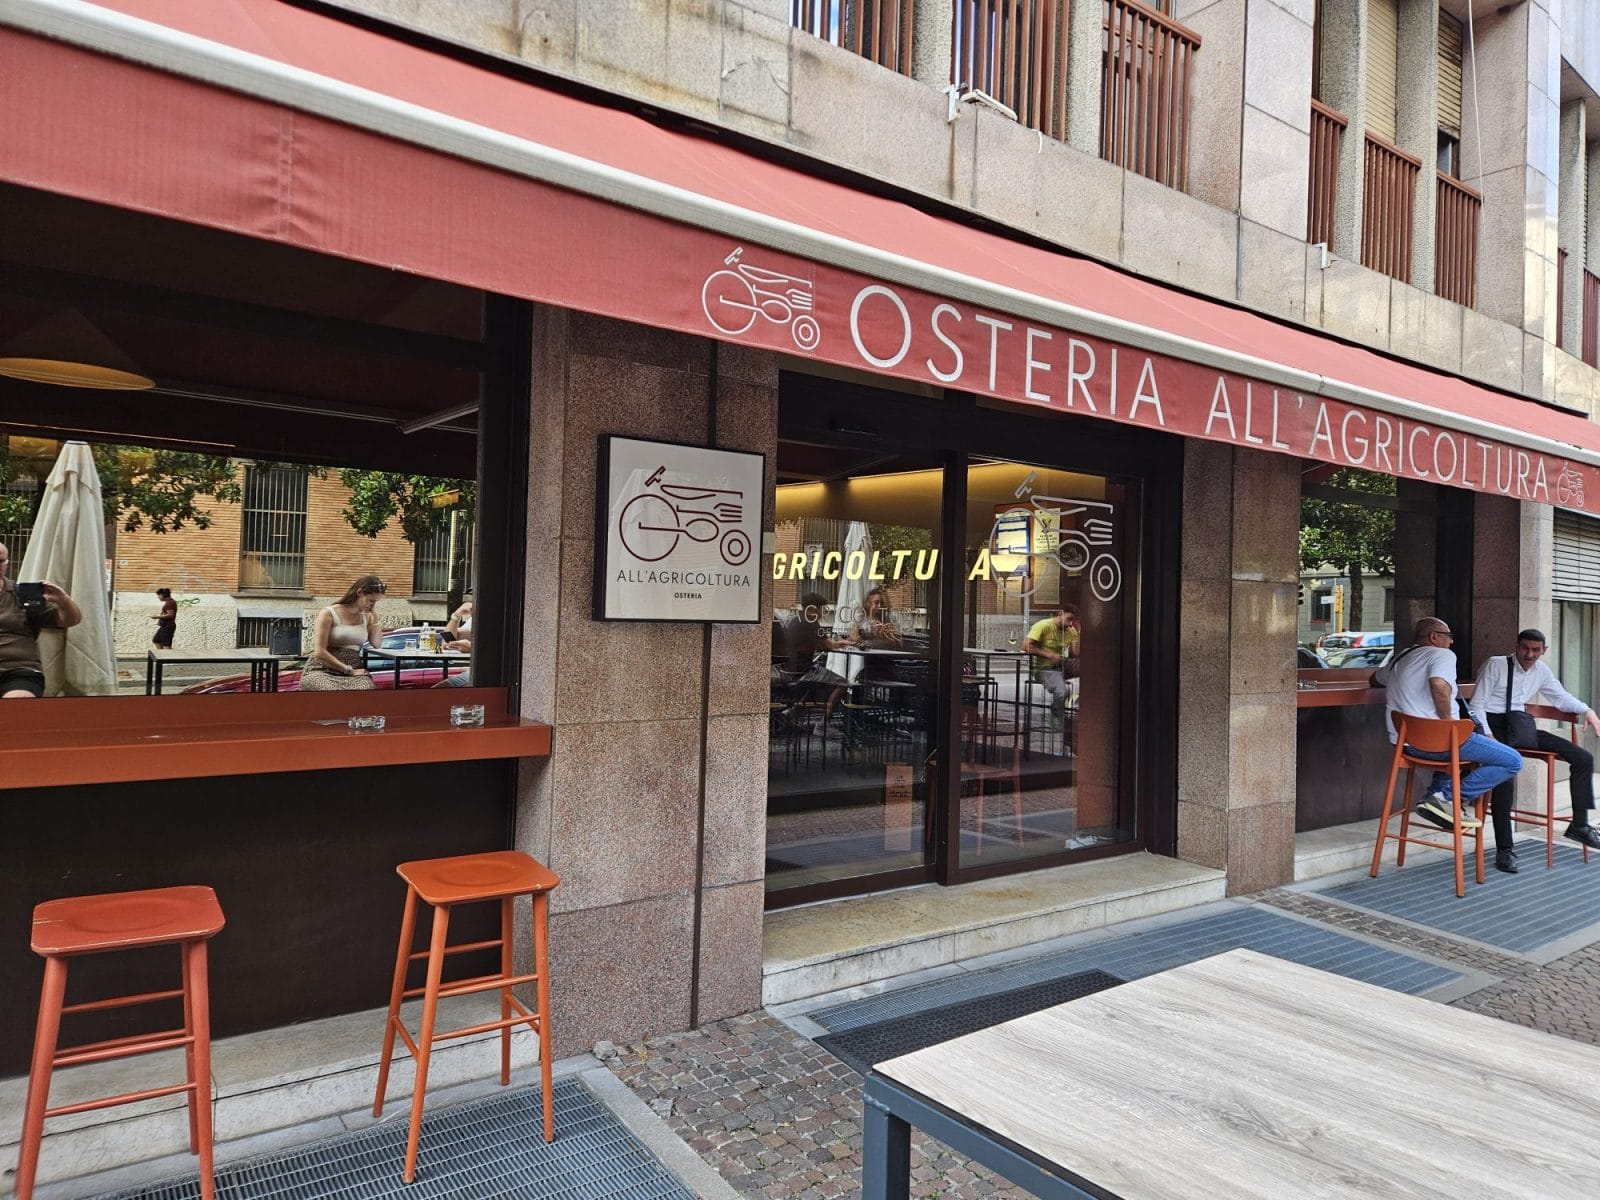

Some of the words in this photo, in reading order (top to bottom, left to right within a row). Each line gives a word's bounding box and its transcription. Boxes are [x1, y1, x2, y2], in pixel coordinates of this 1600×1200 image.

[850, 285, 1165, 425] OSTERIA
[1205, 376, 1549, 500] ALL'AGRICOLTURA
[617, 569, 750, 587] ALL'AGRICOLTURA
